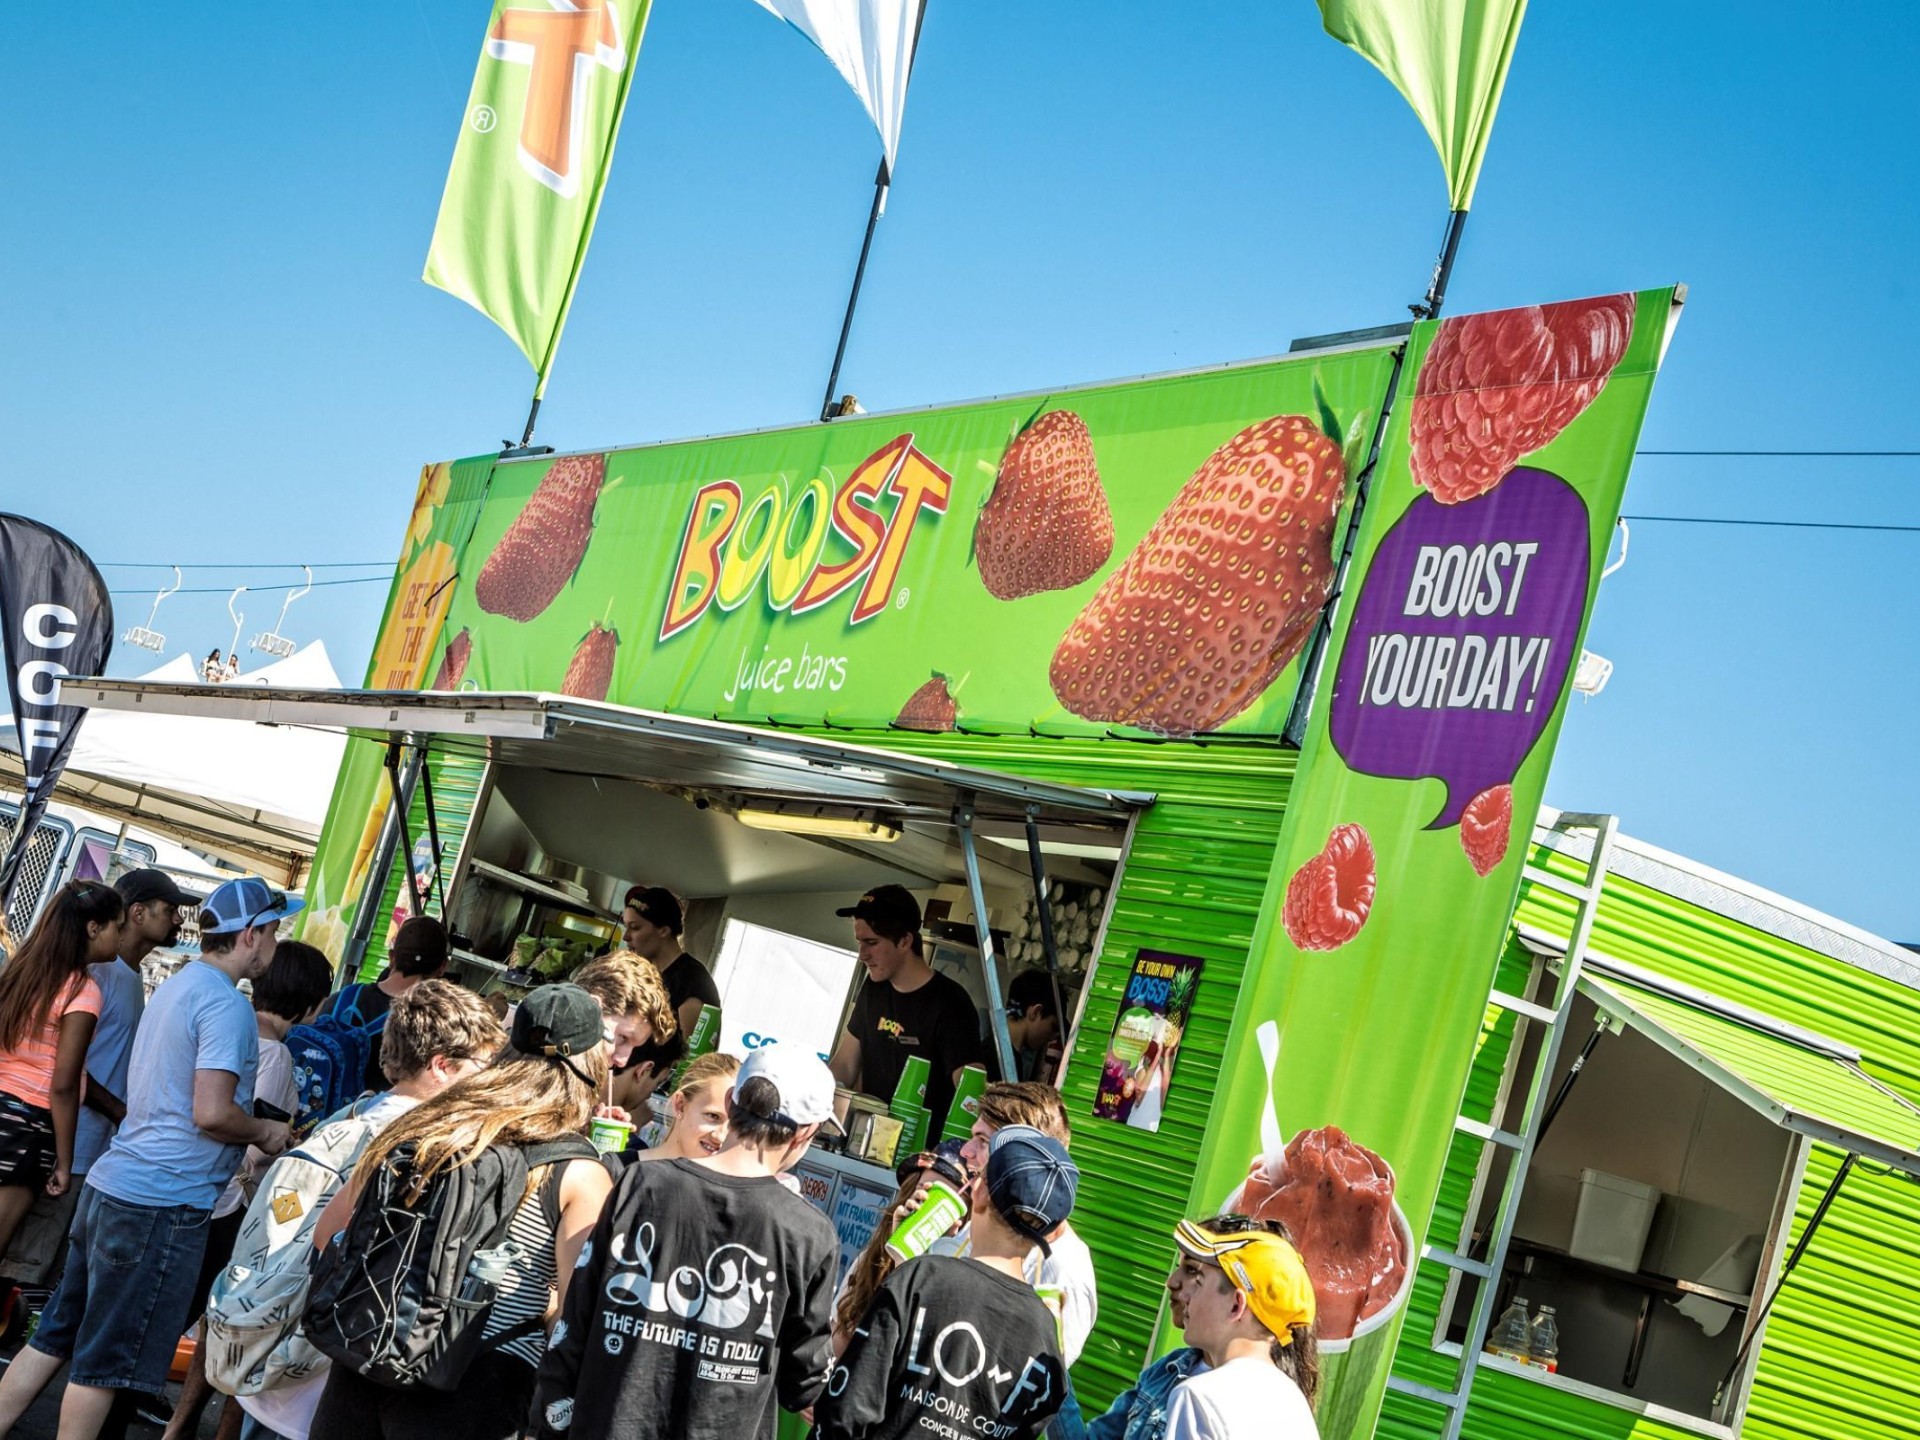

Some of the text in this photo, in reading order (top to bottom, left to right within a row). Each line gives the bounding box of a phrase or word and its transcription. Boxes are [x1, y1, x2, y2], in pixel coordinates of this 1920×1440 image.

[659, 433, 953, 642] BOOST
[1403, 541, 1538, 617] BOOST
[793, 642, 847, 691] bars
[1128, 975, 1171, 1007] BOSS!
[802, 1176, 829, 1202] BERRY
[849, 1206, 881, 1227] FRANKLI
[603, 1311, 764, 1362] THE FUTURE IS NOW
[900, 1384, 956, 1418] MAISON
[955, 1403, 970, 1424] DE
